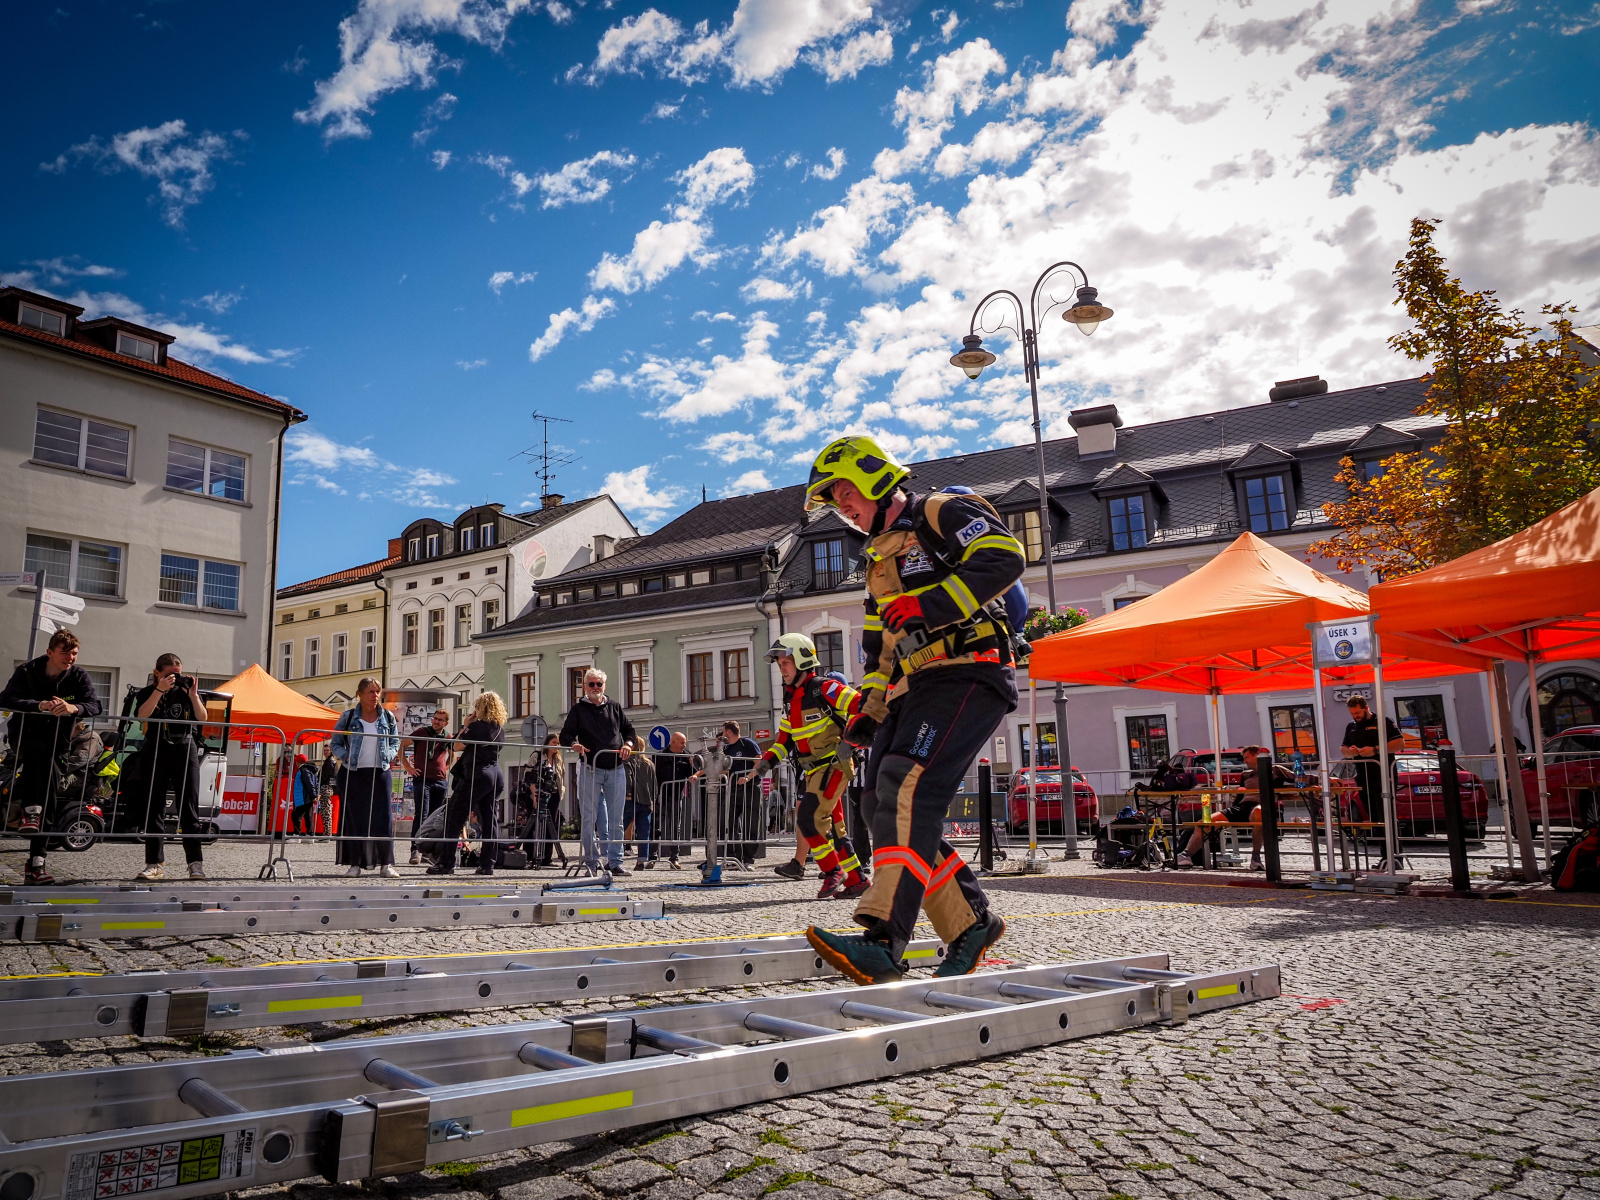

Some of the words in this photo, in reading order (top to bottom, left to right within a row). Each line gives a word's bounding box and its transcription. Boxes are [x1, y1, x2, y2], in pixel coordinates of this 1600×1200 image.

[961, 522, 984, 541] KTO
[1328, 628, 1349, 638] ÚSEK
[1352, 627, 1358, 636] 3
[1333, 690, 1373, 702] ČSOB
[222, 799, 254, 811] obcat
[244, 1131, 254, 1153] PROFI
